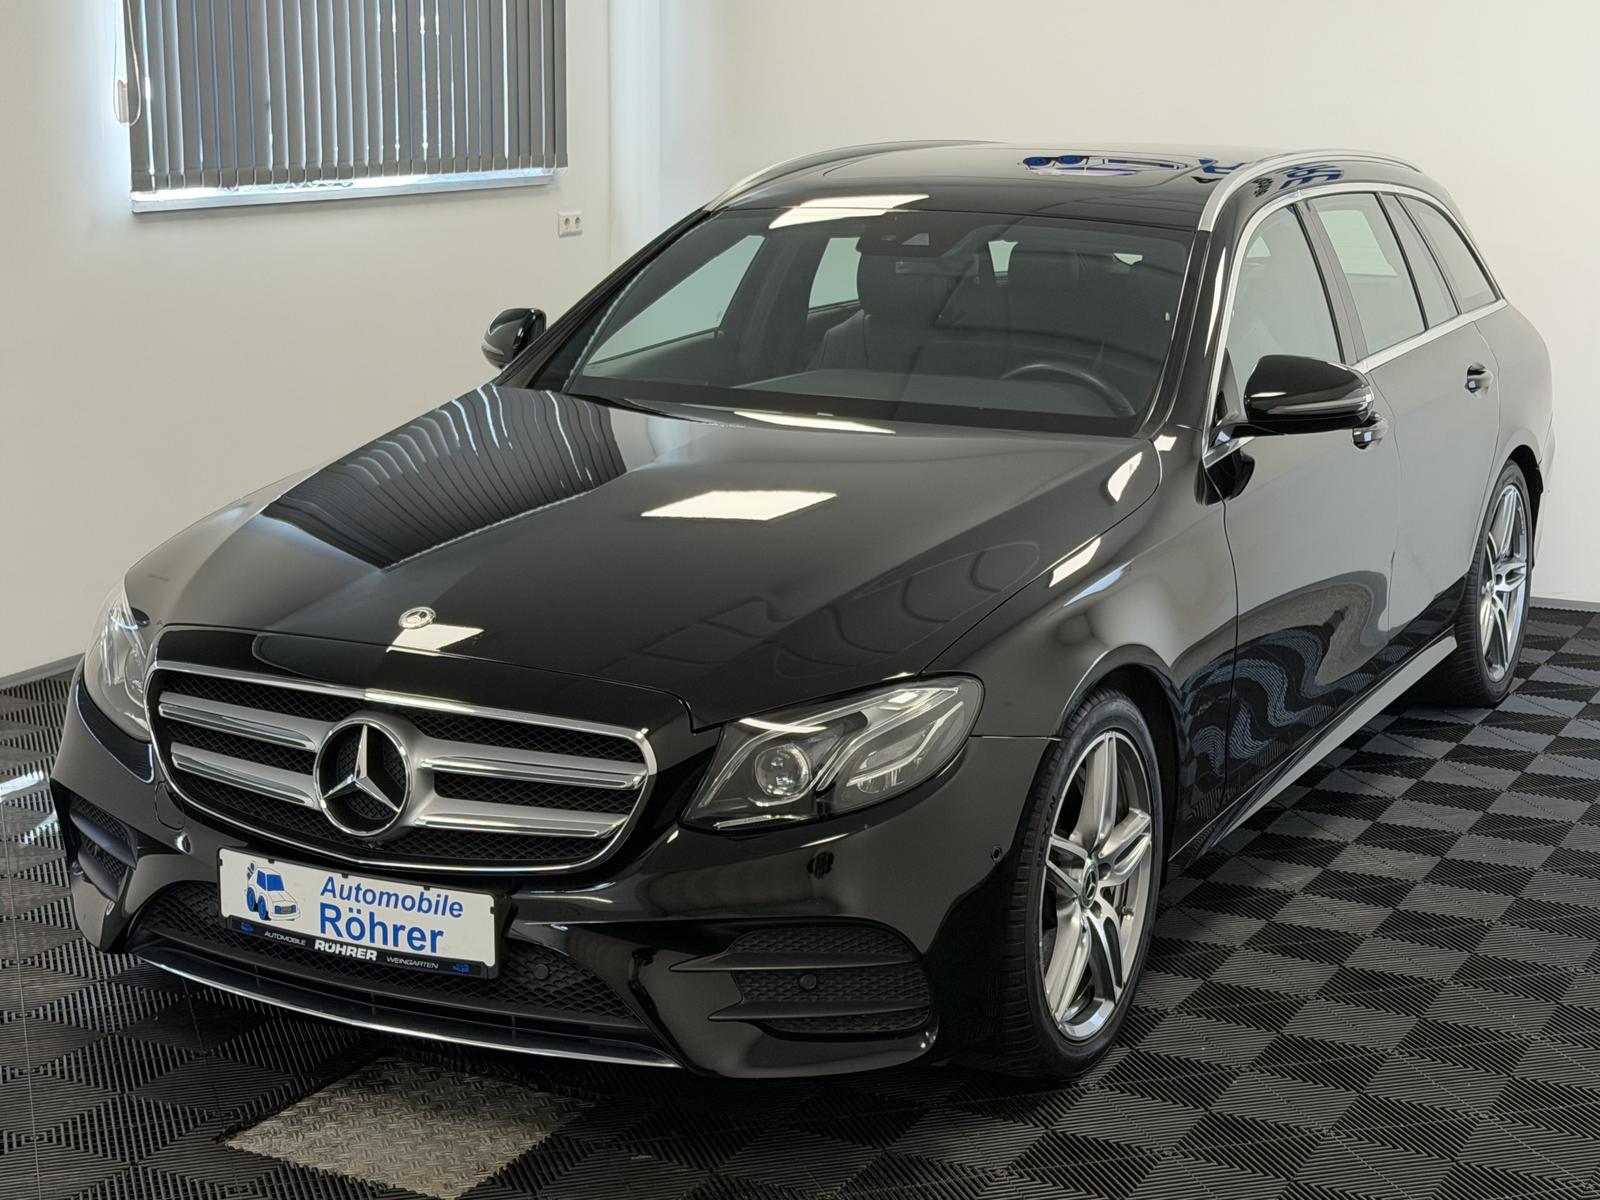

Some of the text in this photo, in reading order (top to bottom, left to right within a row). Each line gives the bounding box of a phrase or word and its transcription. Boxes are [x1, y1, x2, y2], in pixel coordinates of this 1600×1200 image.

[320, 876, 464, 918] Automobile
[319, 902, 444, 954] Röhrer
[264, 930, 439, 969] AUTOMOBILE RÖHRER WEINGARTEN
